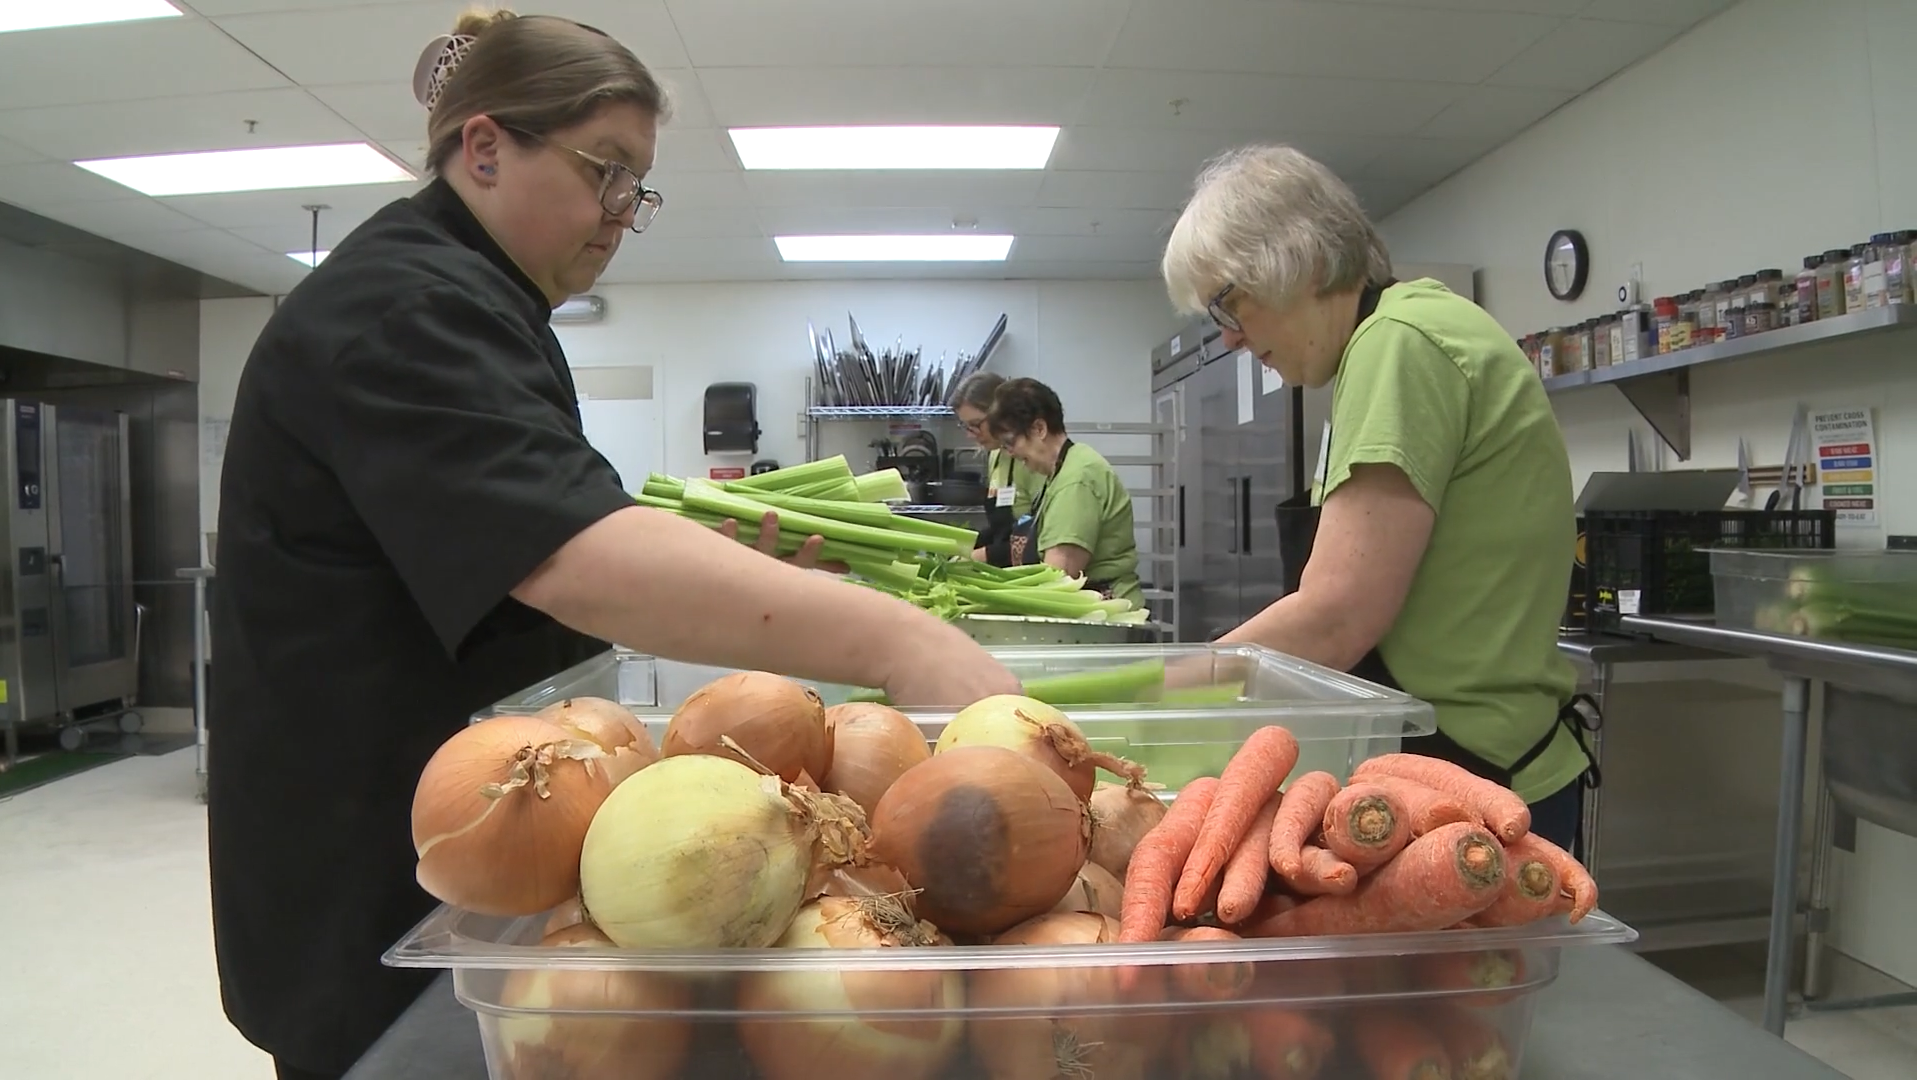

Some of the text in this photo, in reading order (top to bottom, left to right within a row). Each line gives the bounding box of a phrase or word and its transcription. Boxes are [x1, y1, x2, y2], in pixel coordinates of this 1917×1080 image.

[1815, 411, 1865, 423] PREVENT CROSS
[1814, 420, 1868, 432] CONTAMINATION
